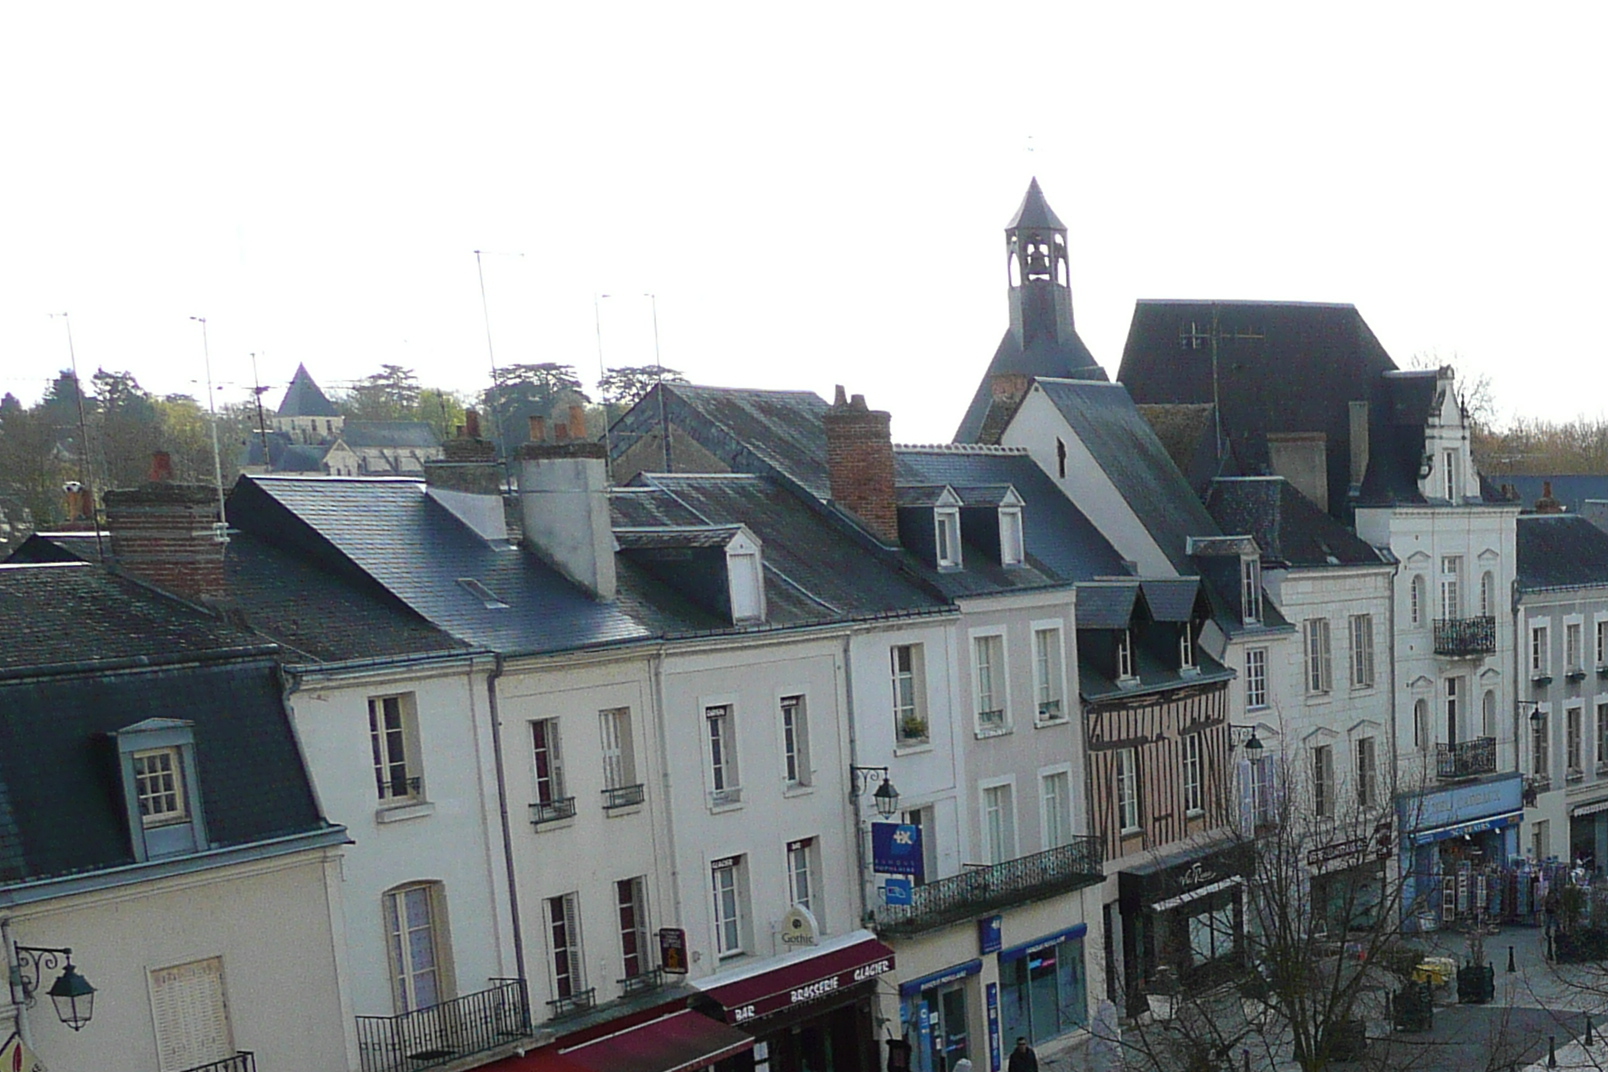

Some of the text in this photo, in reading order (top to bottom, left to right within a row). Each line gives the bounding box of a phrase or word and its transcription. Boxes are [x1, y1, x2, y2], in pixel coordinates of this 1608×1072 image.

[781, 932, 814, 945] Gothic
[734, 960, 890, 1022] BAR BRASSERIE GLACIER
